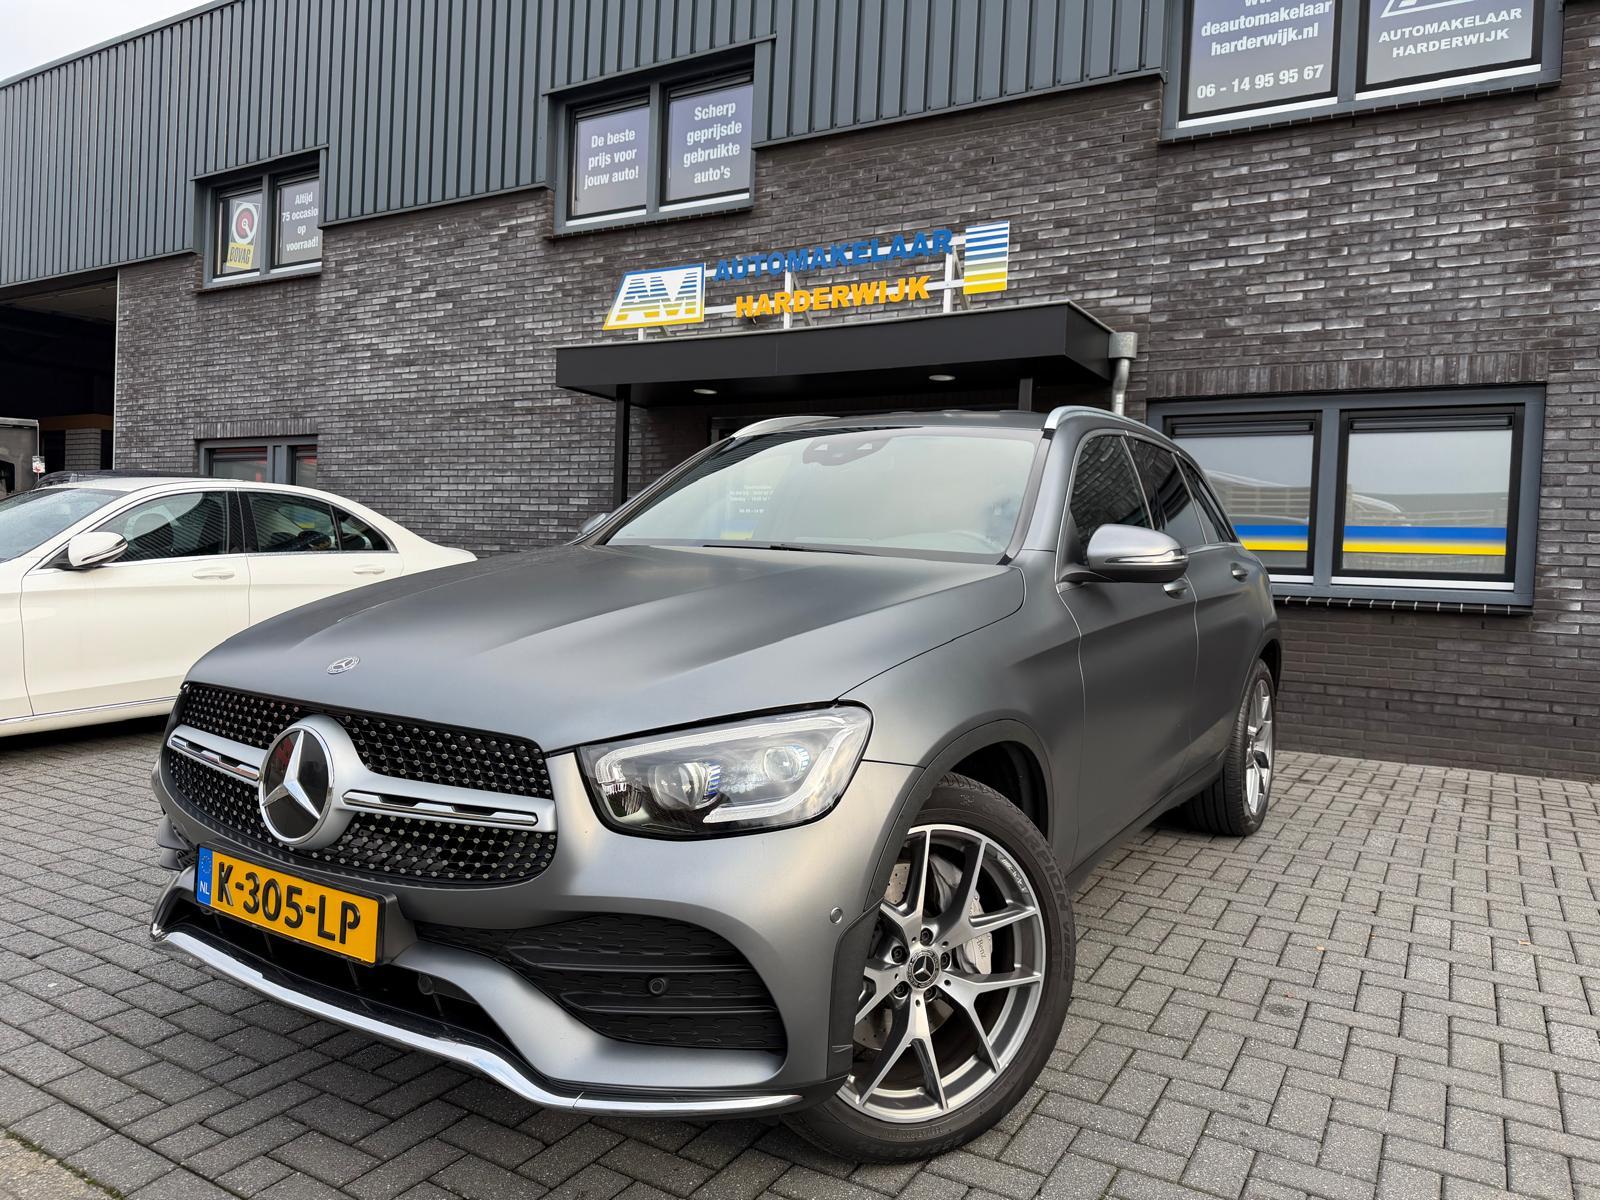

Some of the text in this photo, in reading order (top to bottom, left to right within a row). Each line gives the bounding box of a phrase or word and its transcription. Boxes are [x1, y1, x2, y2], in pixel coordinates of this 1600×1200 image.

[1201, 0, 1333, 36] deautomakelaar
[1378, 8, 1522, 43] AUTOMAKELAAR
[1211, 22, 1319, 56] harderwijk.nl
[1392, 28, 1510, 58] HARDERWIJK
[1197, 83, 1216, 99] 06
[1231, 77, 1250, 93] 14
[1254, 73, 1274, 89] 95
[1279, 68, 1299, 85] 95
[1303, 64, 1324, 80] 67
[694, 102, 736, 121] Scherp
[591, 129, 636, 148] De beste
[686, 121, 742, 145] geprijsde
[588, 149, 637, 171] prijs voor
[683, 143, 740, 167] gebruikte
[584, 165, 639, 190] jouw auto!
[694, 166, 731, 184] auto's
[294, 192, 313, 206] Altijd
[282, 206, 319, 222] 75 occasio
[297, 225, 307, 236] op
[229, 246, 251, 265] BOVAG
[286, 236, 319, 252] voorraad!
[712, 228, 953, 282] AUTOMAKELAAR
[735, 275, 931, 318] HARDERWIJK
[200, 880, 210, 896] NL
[217, 861, 361, 945] K-305-LP
